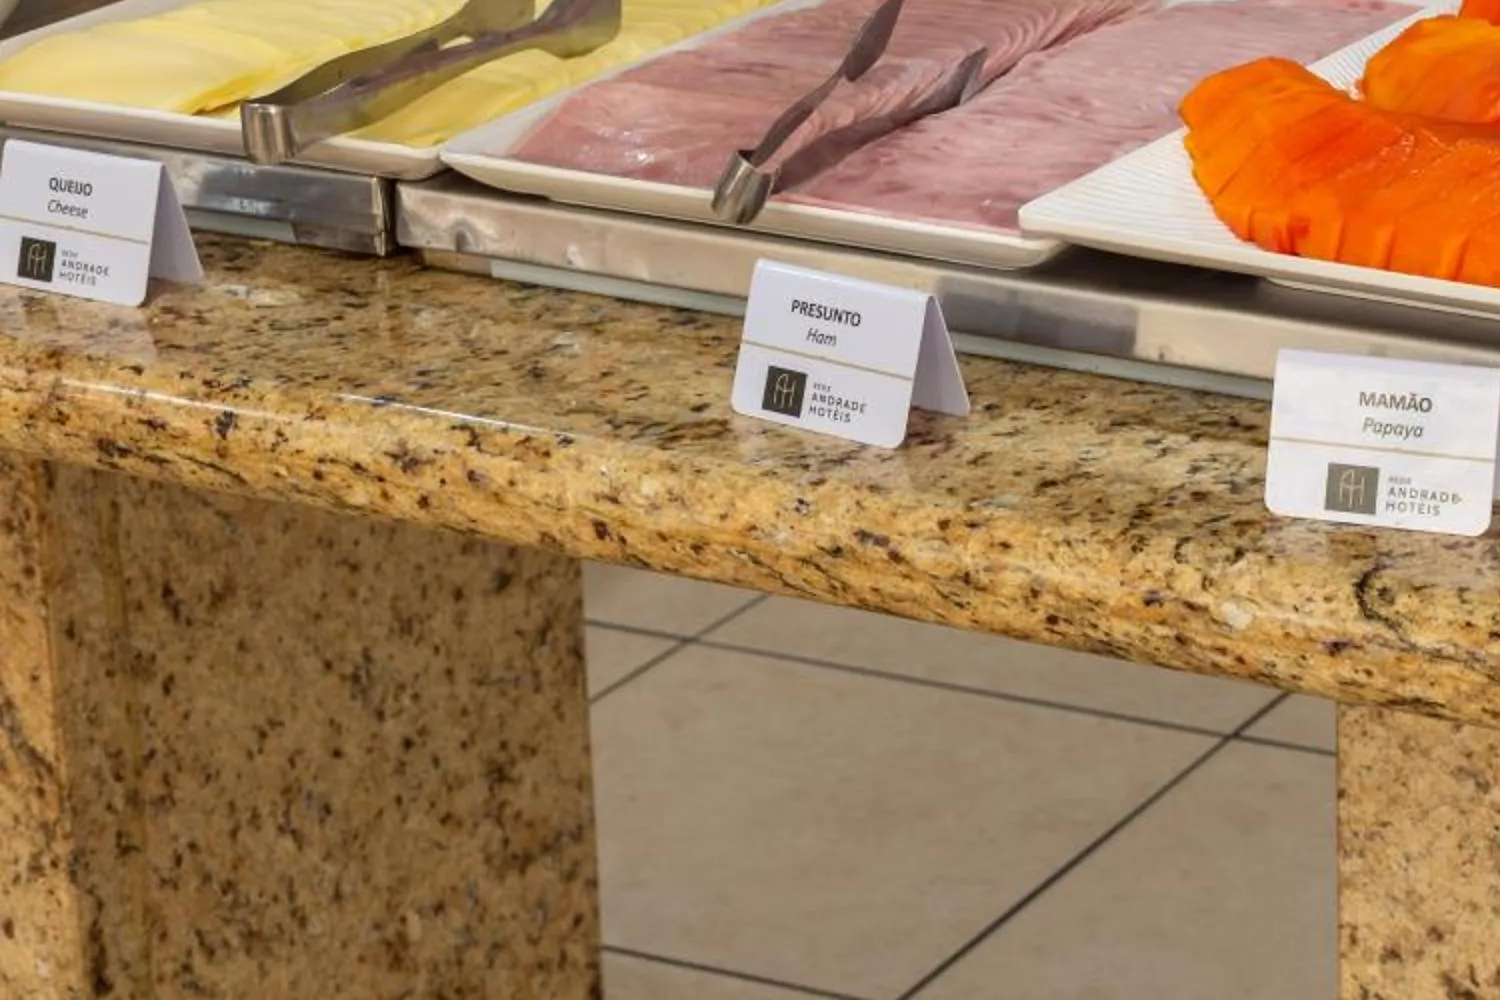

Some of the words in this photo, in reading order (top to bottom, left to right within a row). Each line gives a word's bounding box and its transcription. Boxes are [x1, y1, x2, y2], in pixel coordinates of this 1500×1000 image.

[49, 177, 93, 197] QUEIJO
[47, 199, 89, 219] Cheese
[791, 299, 861, 327] PRESUNTO
[805, 328, 837, 346] Ham
[811, 391, 867, 414] ANDRADE
[1359, 391, 1432, 413] MAMÃO
[808, 406, 851, 423] HOTÉIS
[1362, 417, 1424, 440] Papaya
[1387, 486, 1462, 505] ANDRADE
